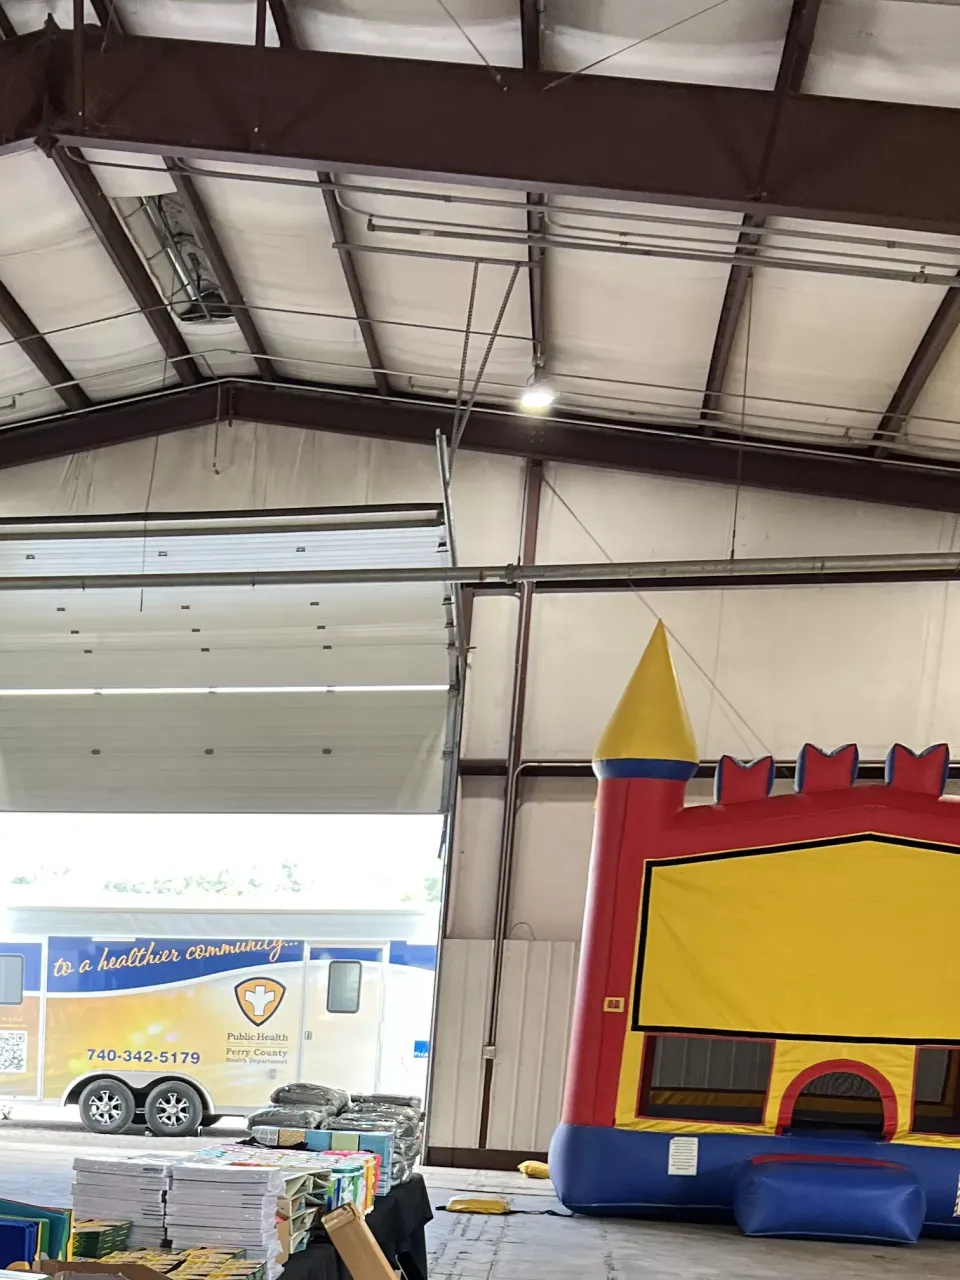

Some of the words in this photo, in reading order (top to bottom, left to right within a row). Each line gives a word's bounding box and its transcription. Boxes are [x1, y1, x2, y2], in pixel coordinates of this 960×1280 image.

[53, 957, 74, 977] to
[79, 959, 93, 974] a
[97, 941, 181, 971] healthier
[227, 1032, 256, 1041] Public
[257, 1032, 289, 1042] Health
[87, 1049, 200, 1065] 740-342-5179
[226, 1048, 251, 1057] Perry
[253, 1048, 289, 1058] County
